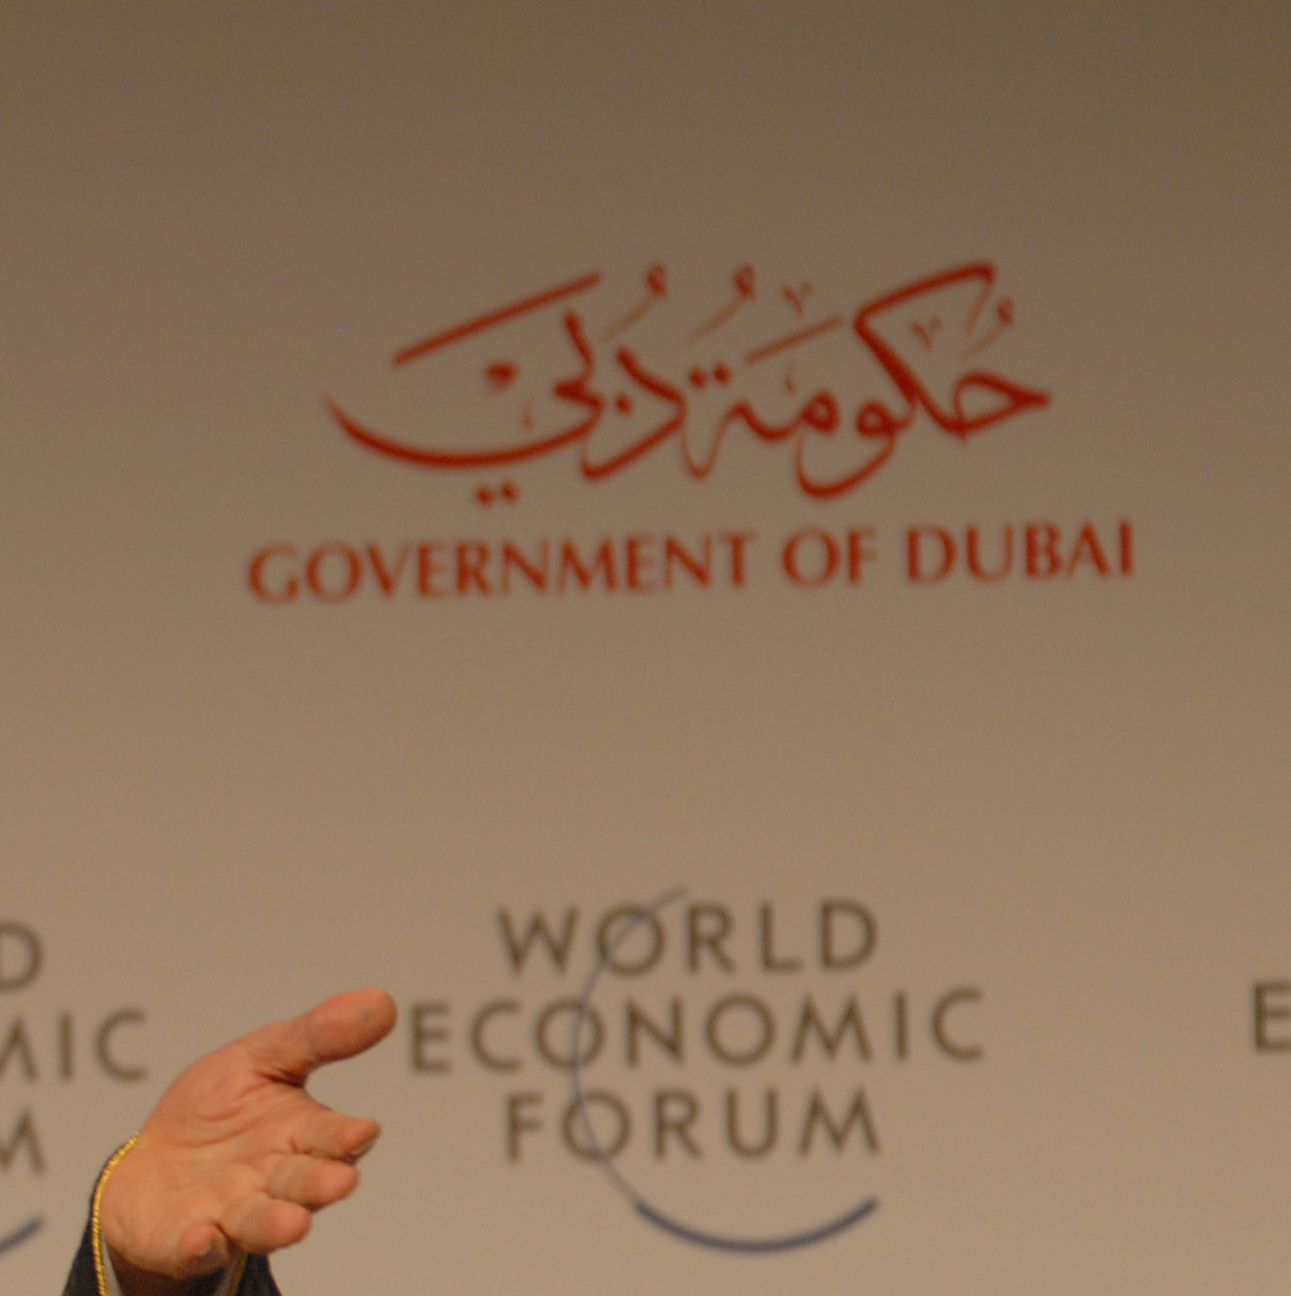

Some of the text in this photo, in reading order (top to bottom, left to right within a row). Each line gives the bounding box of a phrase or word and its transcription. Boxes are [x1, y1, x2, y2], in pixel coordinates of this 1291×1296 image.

[246, 520, 1135, 604] GOVERNMENT OF DUBAI
[498, 900, 878, 976] WORLD
[410, 987, 985, 1075] ECONOMIC
[505, 1088, 882, 1164] FORUM
